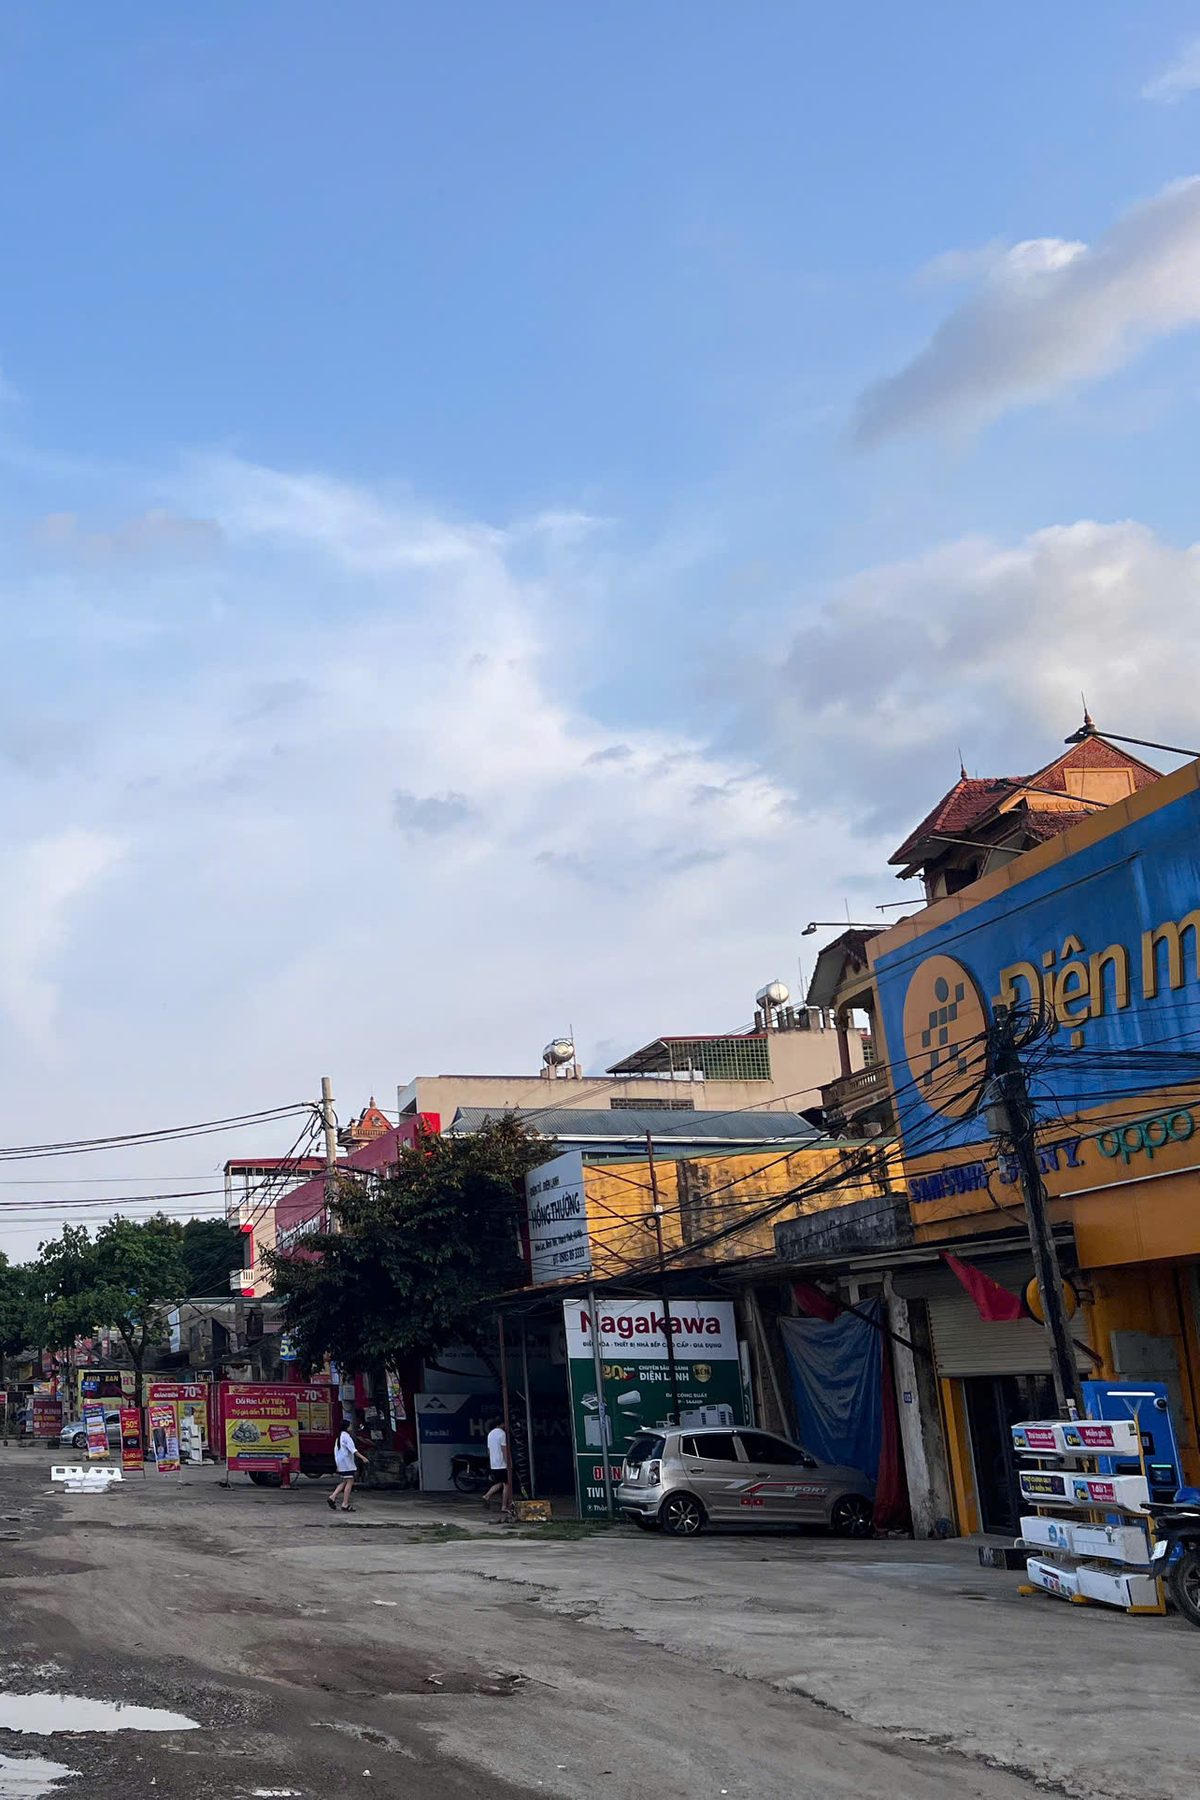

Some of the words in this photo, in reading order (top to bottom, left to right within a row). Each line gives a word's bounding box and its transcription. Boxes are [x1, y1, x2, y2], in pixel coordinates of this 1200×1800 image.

[991, 934, 1130, 1050] Điện
[1096, 1109, 1195, 1165] oppo
[908, 1162, 990, 1204] SAMSUNG
[580, 1311, 721, 1339] Nagakawa
[640, 1371, 662, 1383] ĐIỆN
[663, 1372, 690, 1382] LNH
[587, 1487, 604, 1498] TIVI
[784, 1485, 828, 1493] SPORT
